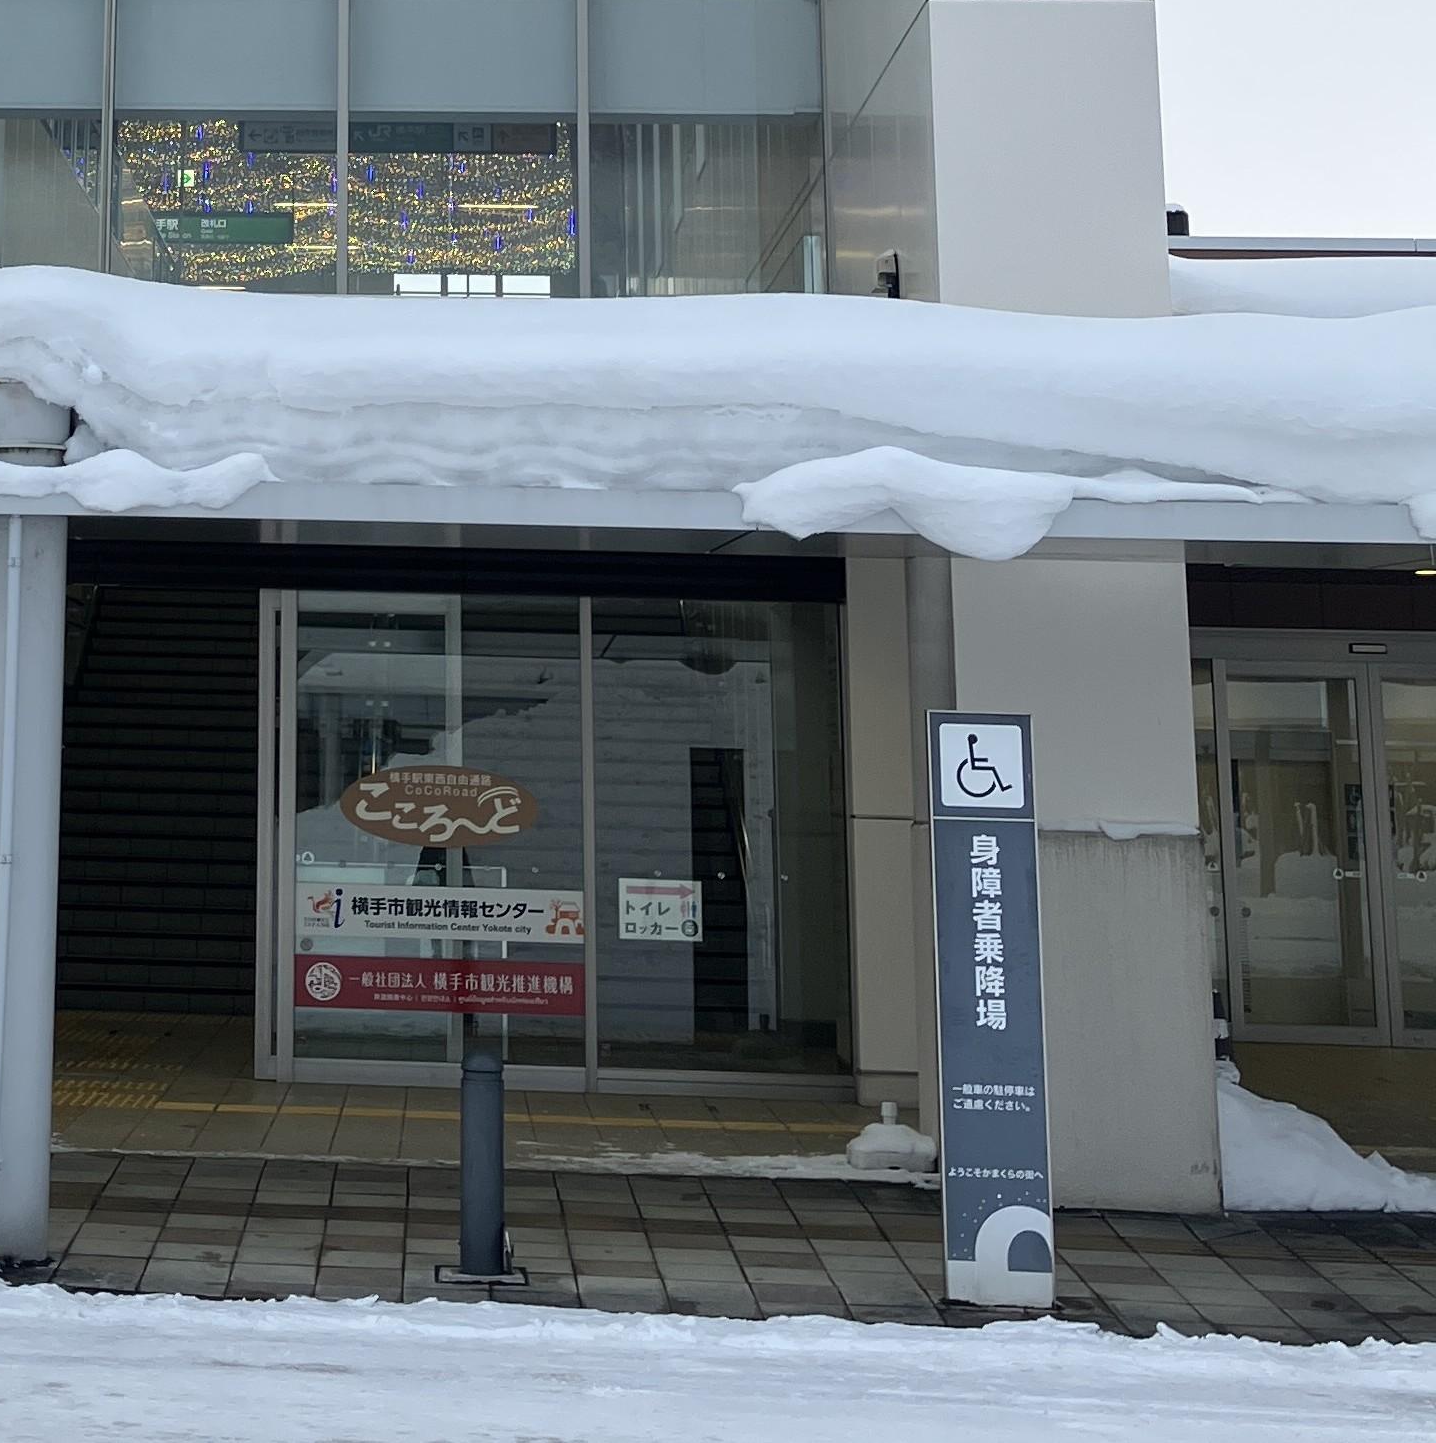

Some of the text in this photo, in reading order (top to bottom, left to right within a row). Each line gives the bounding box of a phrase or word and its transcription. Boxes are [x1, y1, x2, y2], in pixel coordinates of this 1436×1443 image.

[405, 784, 478, 797] CoCoRoad
[351, 896, 545, 920] 横手市観光情報センター
[625, 900, 671, 916] トイレ
[364, 919, 532, 935] Tourist Information Center Yokote city
[625, 921, 679, 935] ロッカー
[969, 833, 1007, 1031] 身障者乗降場
[348, 970, 574, 995] 一般社団法人 横手市観光推進機構
